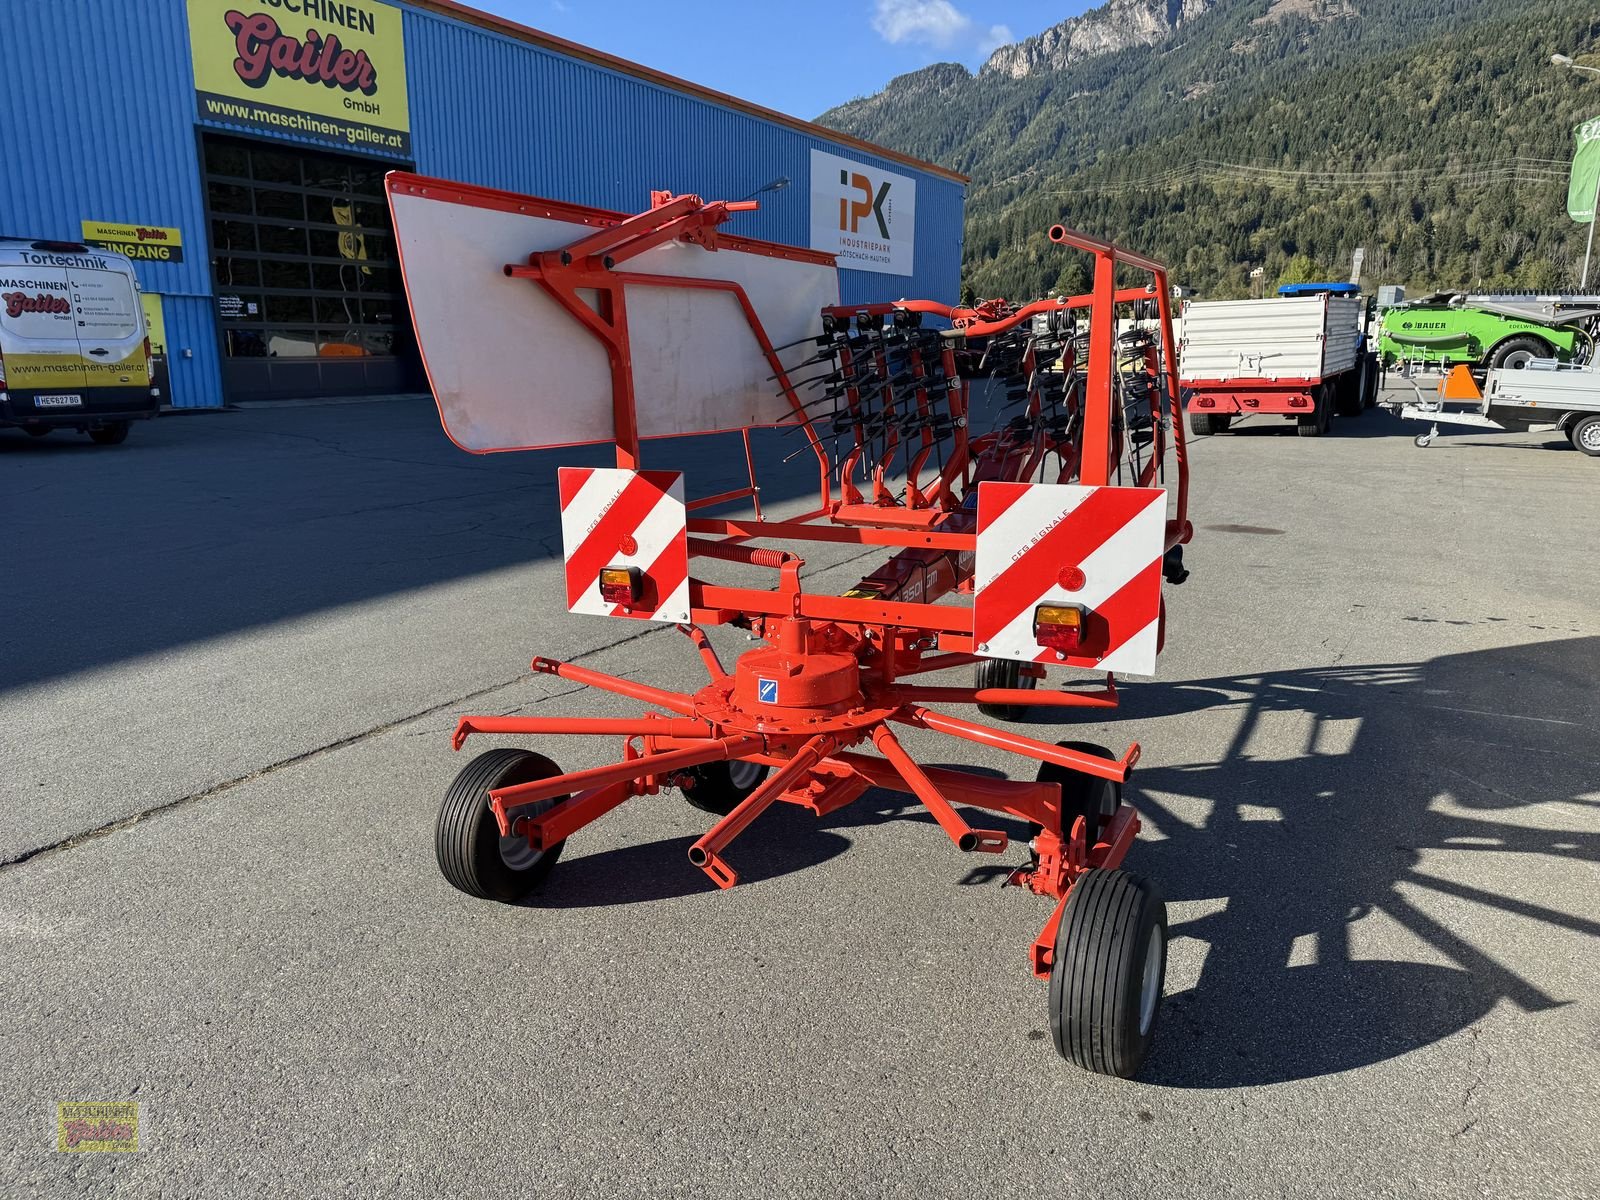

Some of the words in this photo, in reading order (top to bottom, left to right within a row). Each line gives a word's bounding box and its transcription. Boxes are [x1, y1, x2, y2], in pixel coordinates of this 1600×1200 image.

[261, 0, 375, 35] CHINEN
[224, 10, 378, 96] Gailer
[343, 97, 381, 115] GmbH
[206, 99, 403, 148] www.maschinen-gailer.at
[96, 228, 136, 237] MASCHINEN
[839, 237, 891, 253] INDUSTRIEPARK
[19, 252, 108, 269] Tortechnik
[0, 279, 68, 291] MASCHINEN
[1, 292, 71, 318] Gailer
[12, 363, 145, 374] www.maschinen-gailer.at
[1011, 543, 1030, 562] CFG
[1031, 508, 1070, 545] SIGNALE
